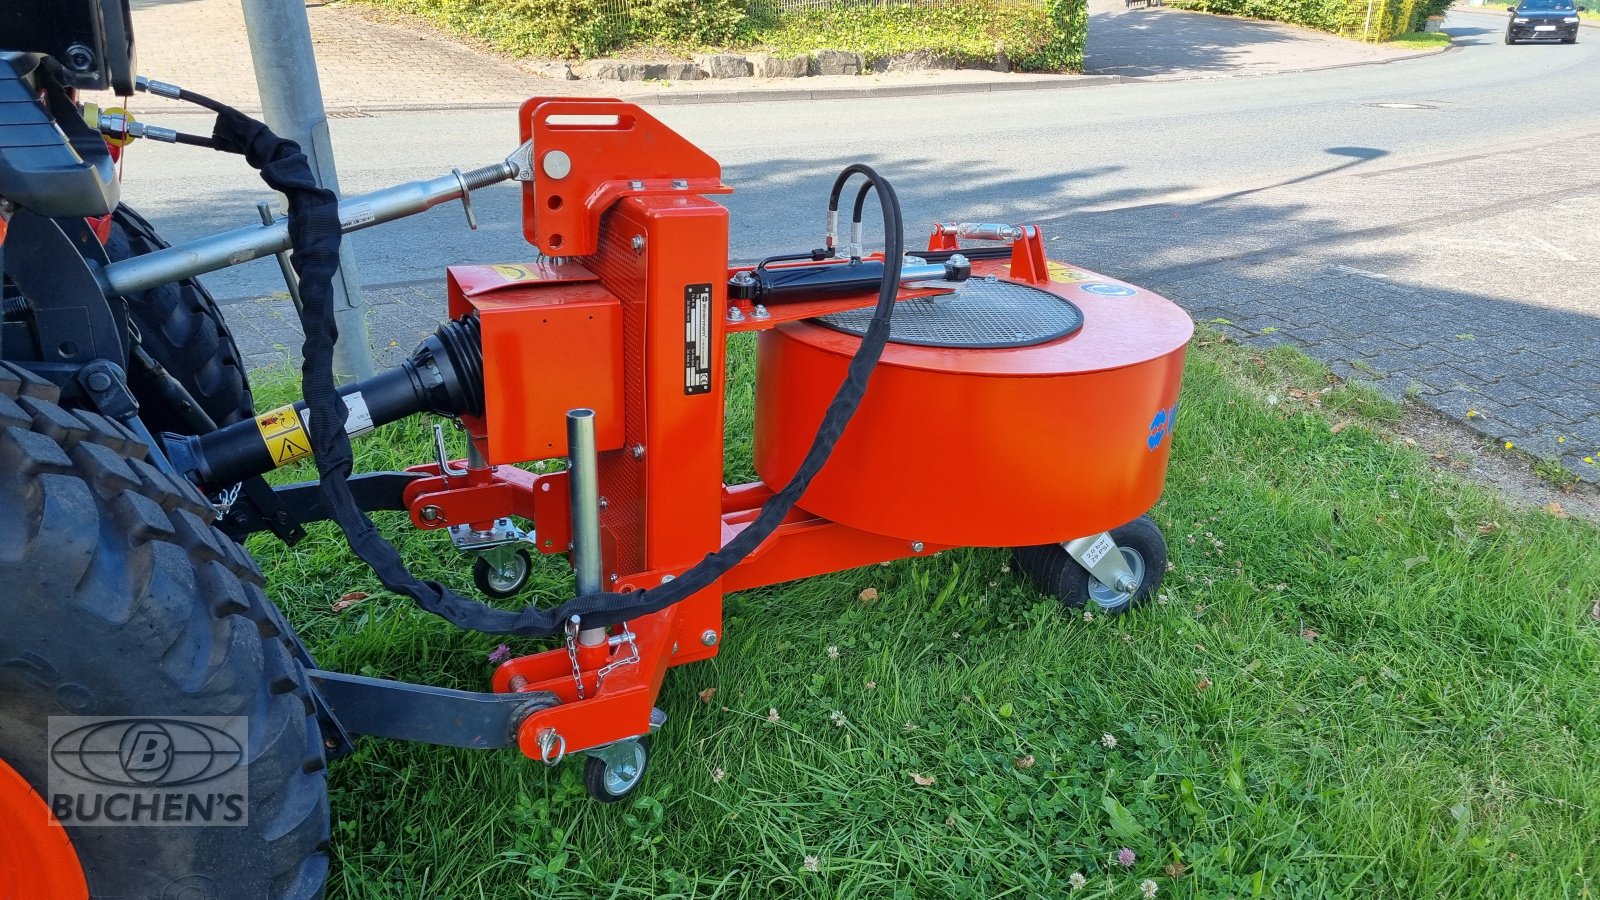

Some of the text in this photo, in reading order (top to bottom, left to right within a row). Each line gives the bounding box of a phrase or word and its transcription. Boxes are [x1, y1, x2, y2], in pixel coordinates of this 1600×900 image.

[1095, 539, 1105, 550] bar
[1091, 543, 1110, 563] 29 PSI
